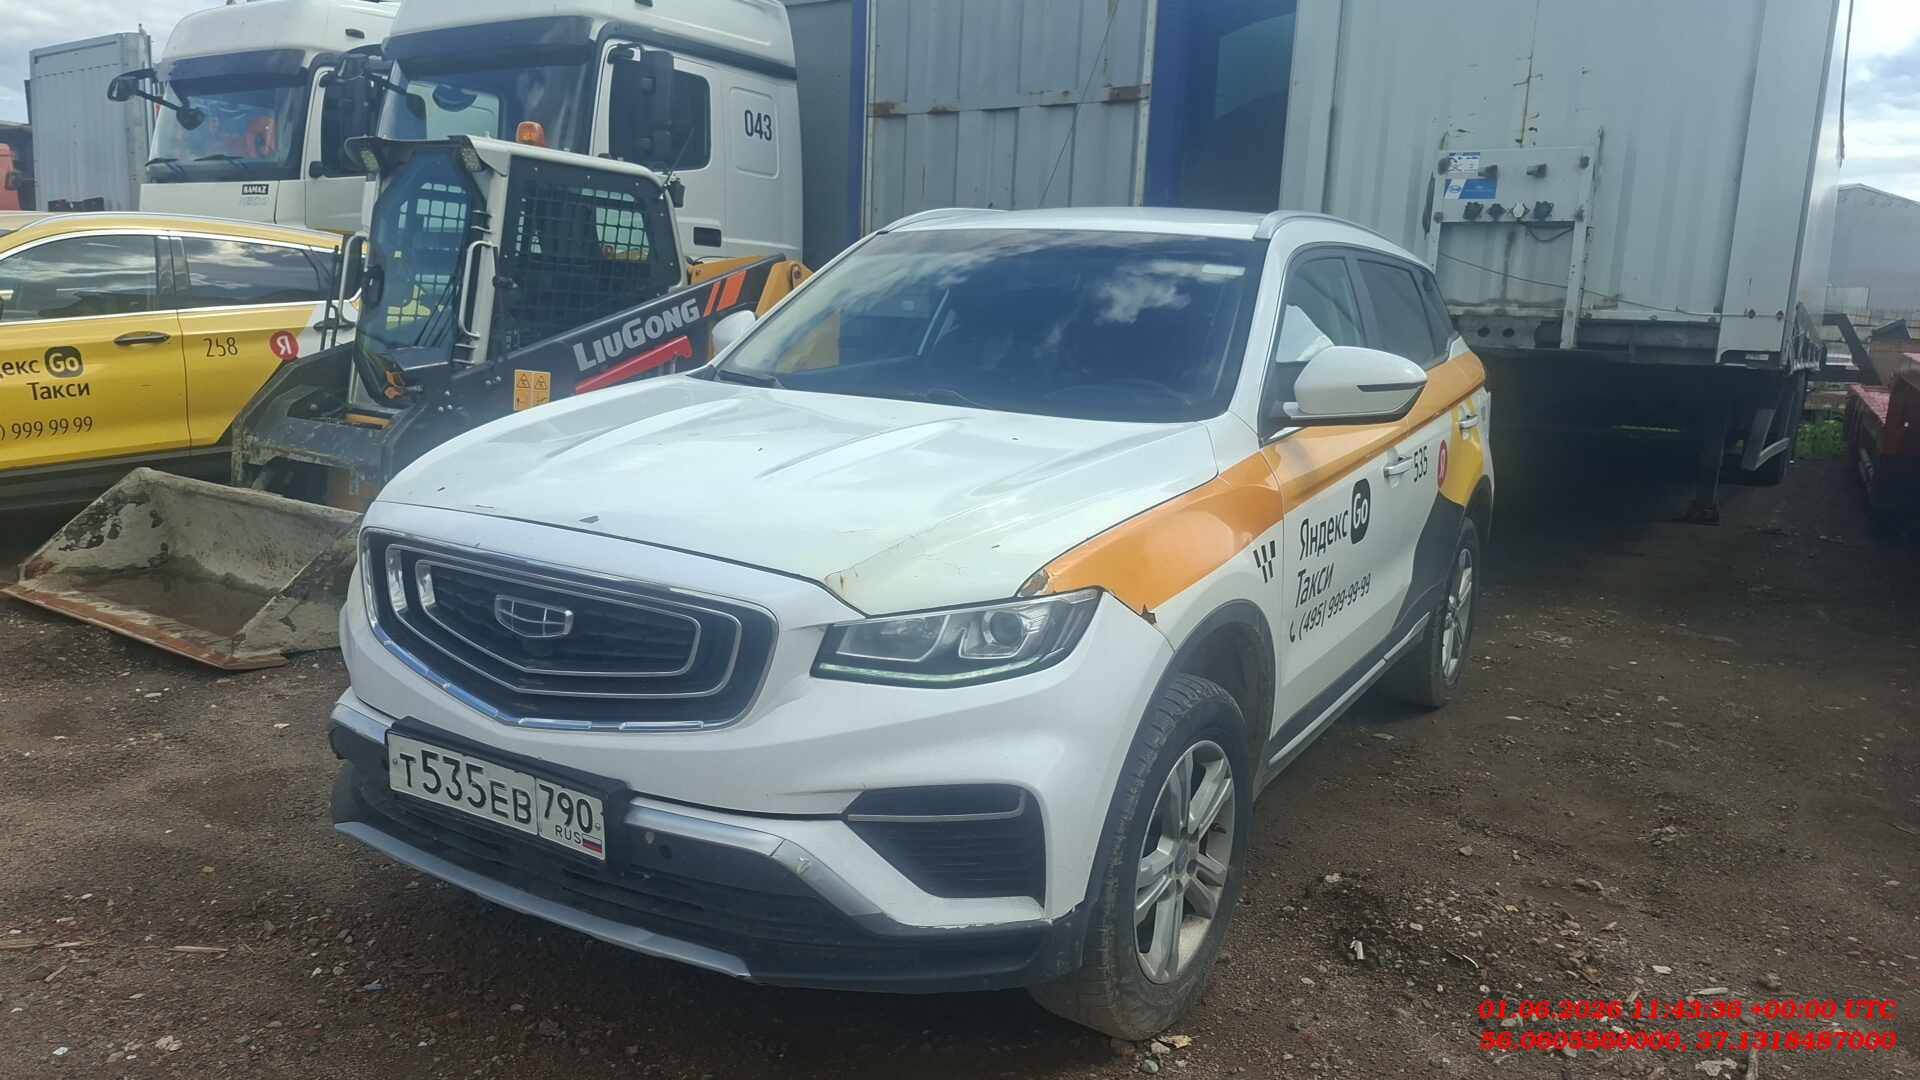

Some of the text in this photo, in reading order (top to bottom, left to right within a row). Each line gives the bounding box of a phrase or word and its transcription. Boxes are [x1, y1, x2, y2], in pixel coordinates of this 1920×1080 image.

[744, 109, 772, 141] 043
[203, 336, 238, 357] 258
[0, 353, 81, 378] екс Go
[26, 382, 91, 400] Такси
[11, 421, 43, 439] 999
[49, 418, 69, 436] 99
[73, 416, 93, 432] 99
[1413, 445, 1428, 483] 535
[1299, 493, 1369, 560] Яндекс Go
[1295, 562, 1334, 608] Такси
[1298, 572, 1371, 640] (495) 999-99-99
[538, 783, 594, 834] 790
[555, 824, 582, 845] RUS
